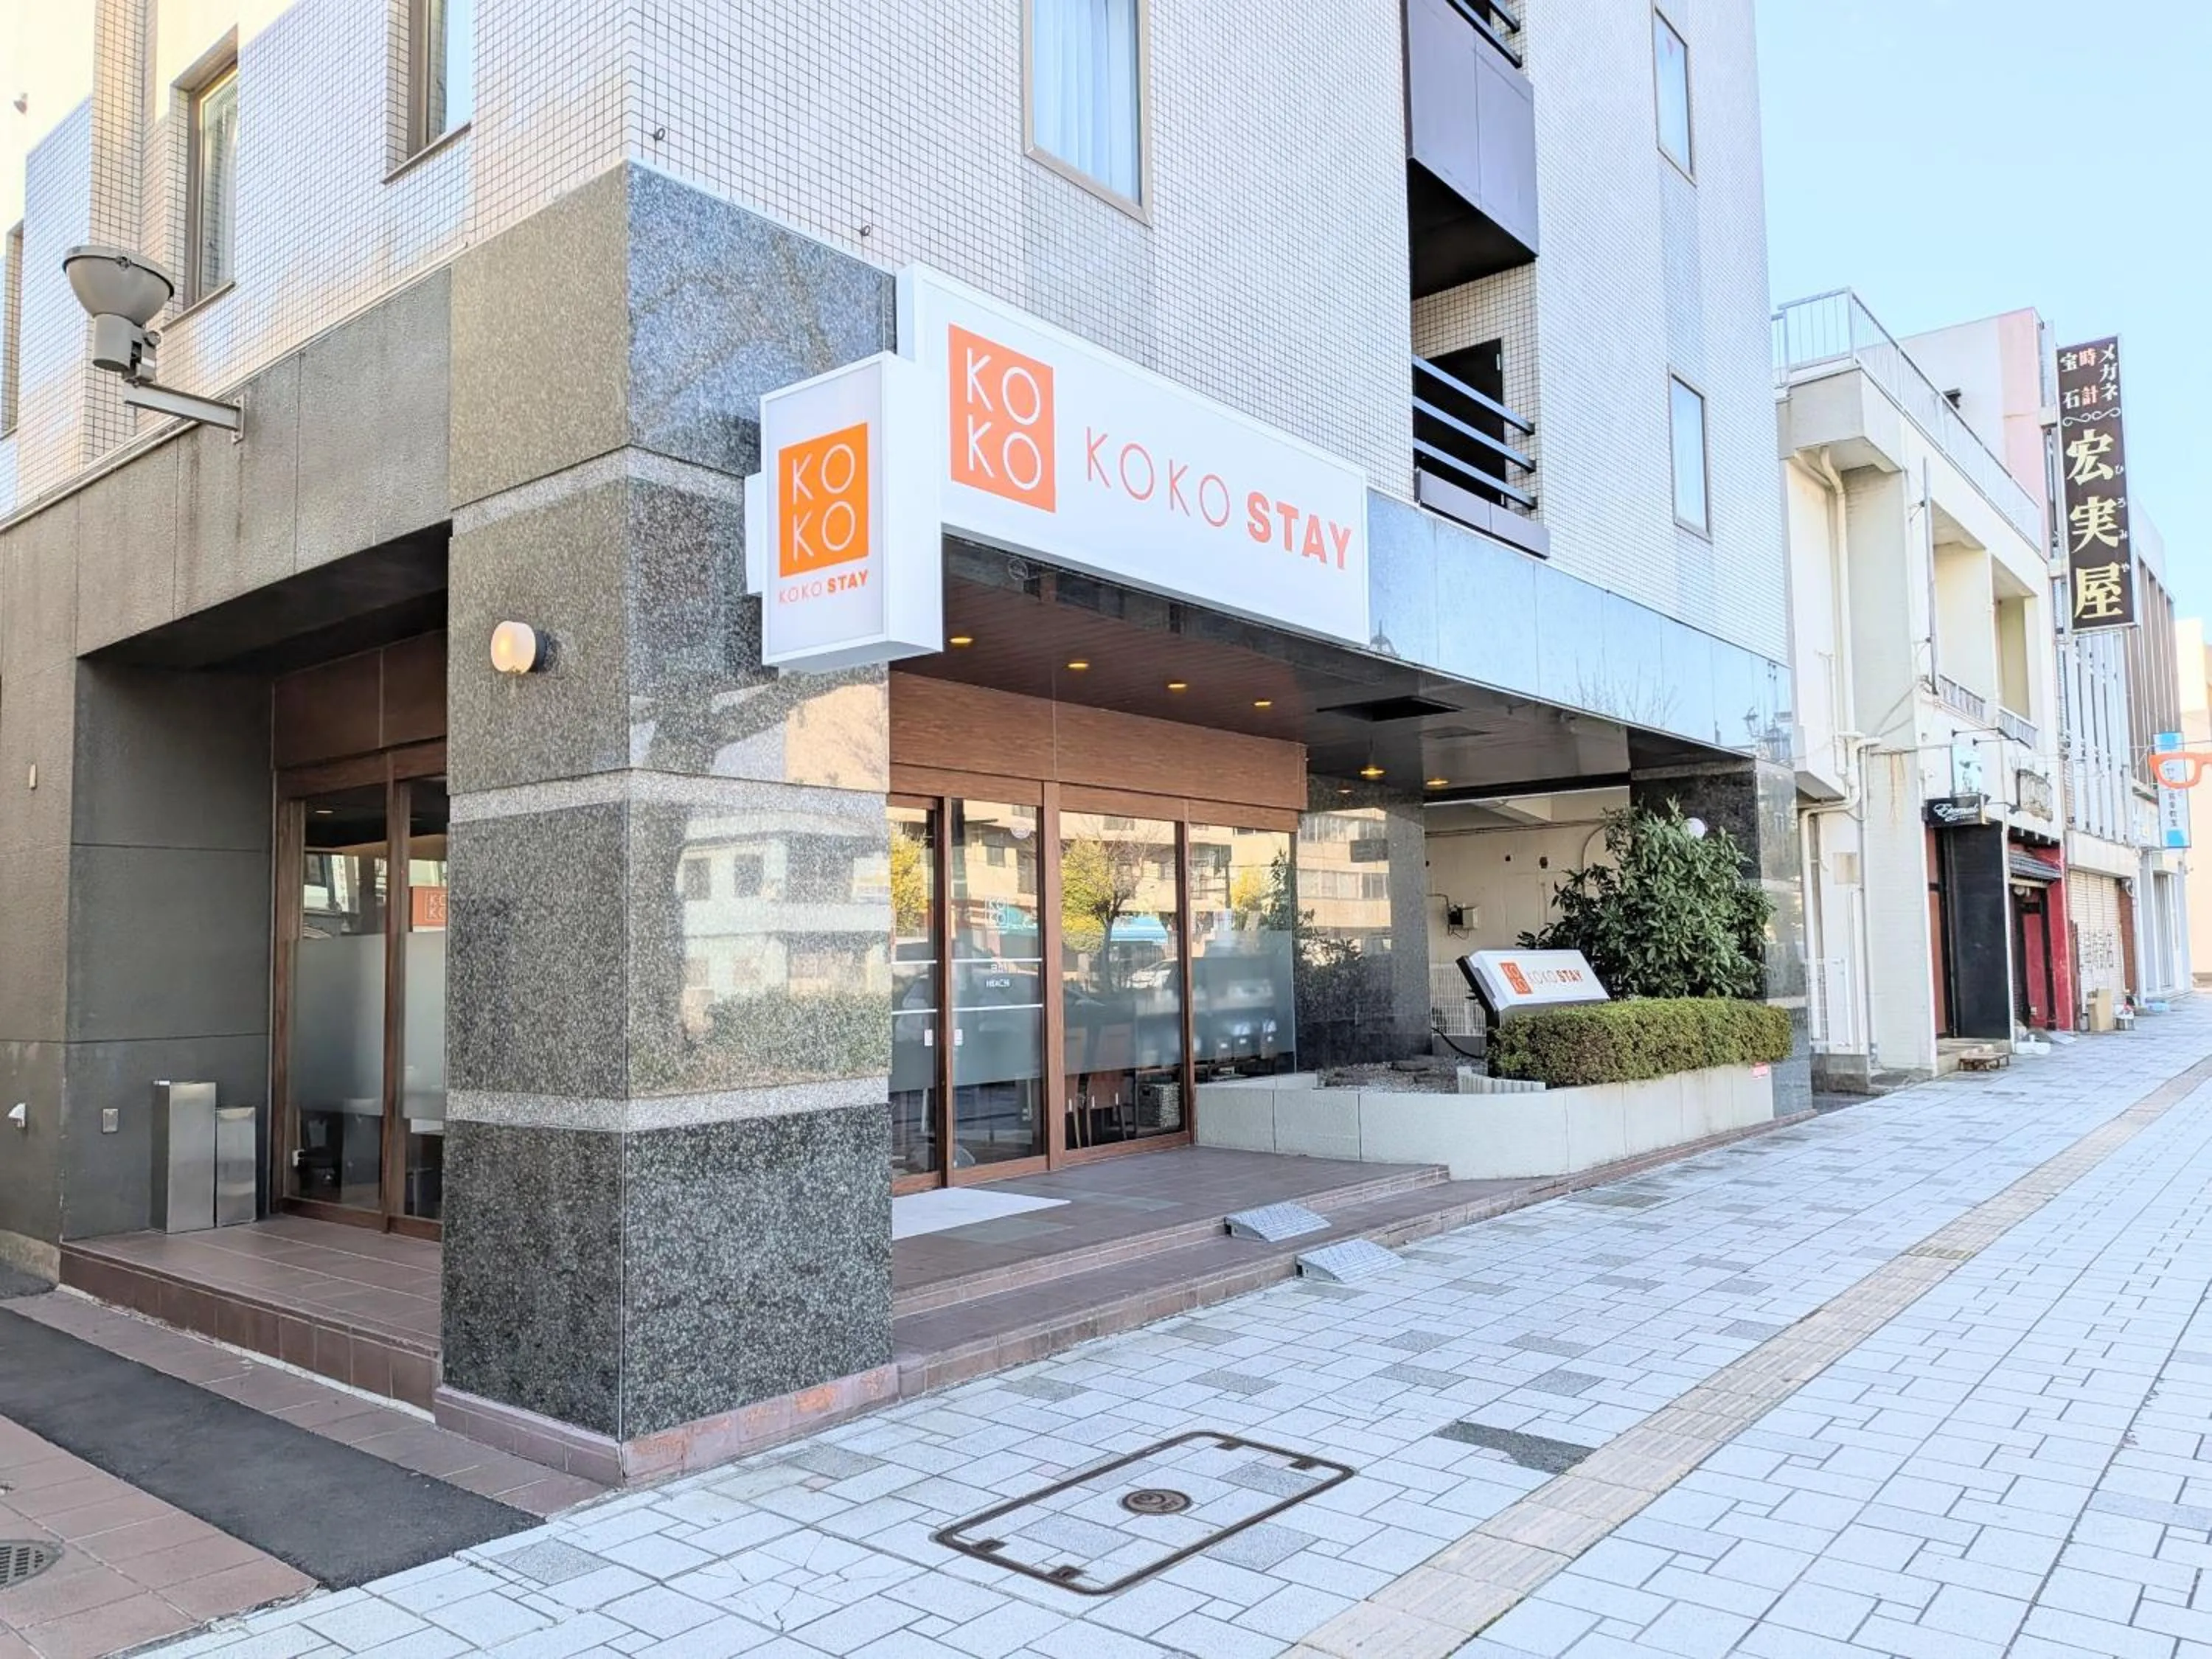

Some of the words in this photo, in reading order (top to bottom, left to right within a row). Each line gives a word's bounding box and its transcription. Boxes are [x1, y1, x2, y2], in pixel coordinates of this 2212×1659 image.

[967, 347, 1041, 425] KO
[2060, 352, 2079, 409] 宝石
[2079, 348, 2098, 406] 時計
[2099, 344, 2118, 401] メガネ
[793, 443, 855, 502] KO
[967, 414, 1043, 491] KO
[1087, 427, 1231, 528] KOKO
[1247, 492, 1352, 569] STAY
[2066, 428, 2124, 619] 宏実屋
[793, 501, 856, 562] KO
[779, 581, 822, 603] KOKO
[827, 569, 869, 593] STAY
[1527, 969, 1557, 985] KOKO
[1556, 969, 1583, 983] STAY
